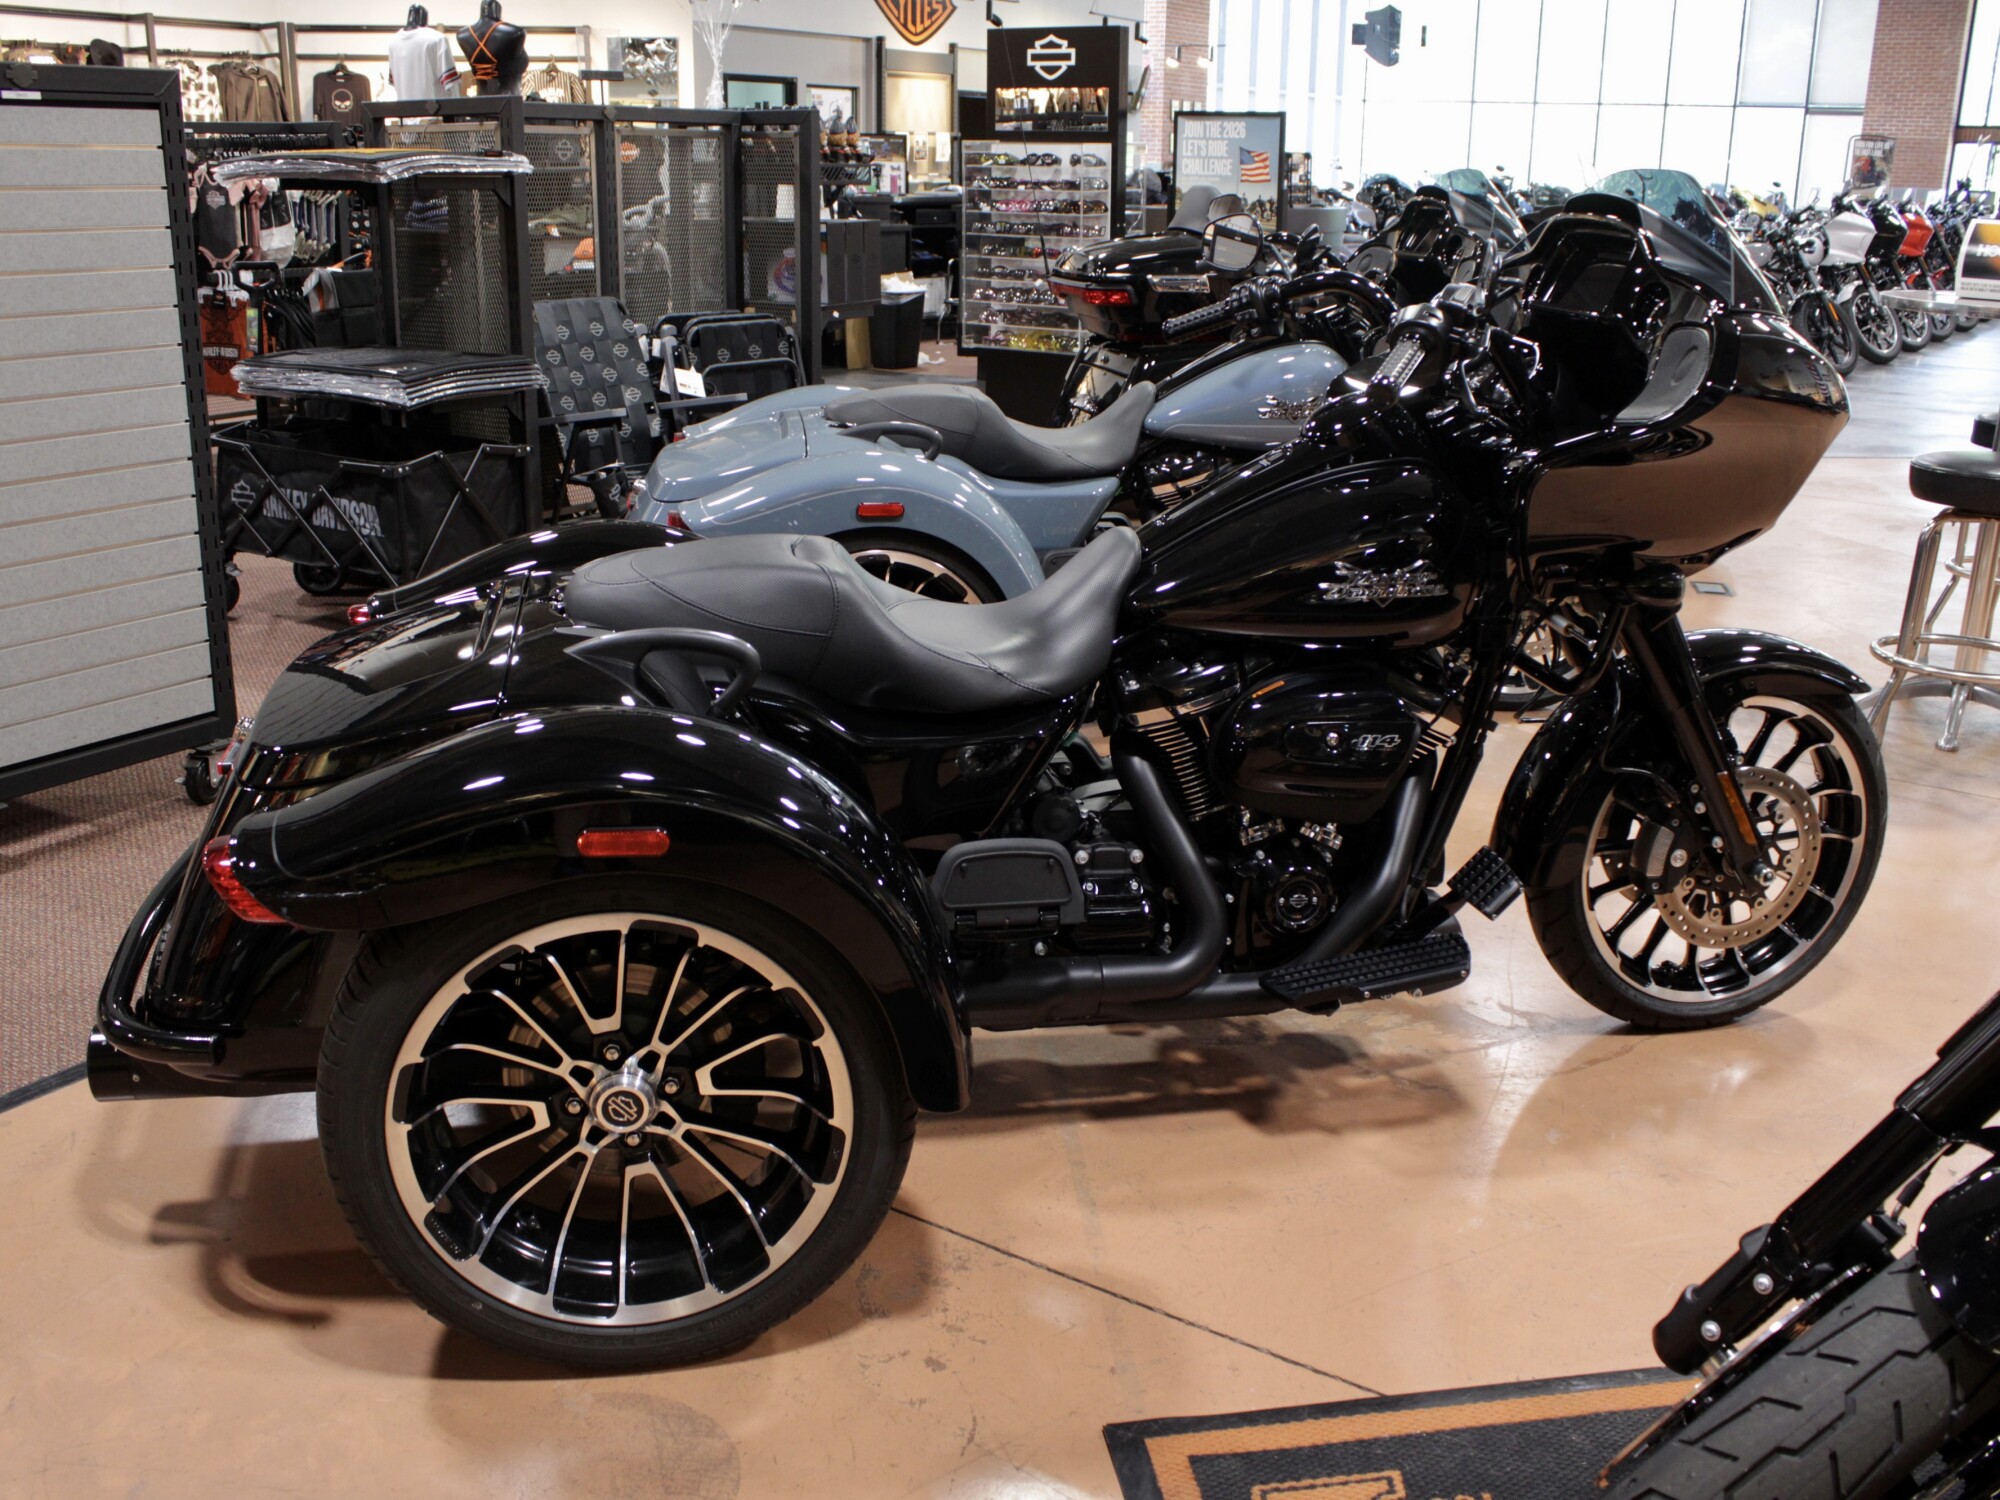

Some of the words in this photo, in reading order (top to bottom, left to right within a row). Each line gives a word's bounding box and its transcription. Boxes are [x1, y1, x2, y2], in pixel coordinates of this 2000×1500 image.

[1183, 121, 1204, 138] JOIN
[1205, 121, 1222, 139] THE
[1223, 121, 1246, 139] 2026
[1183, 140, 1207, 157] LET'S
[1208, 140, 1229, 157] RIDE
[1182, 158, 1233, 176] CHALLENGE
[1357, 734, 1401, 748] 114
